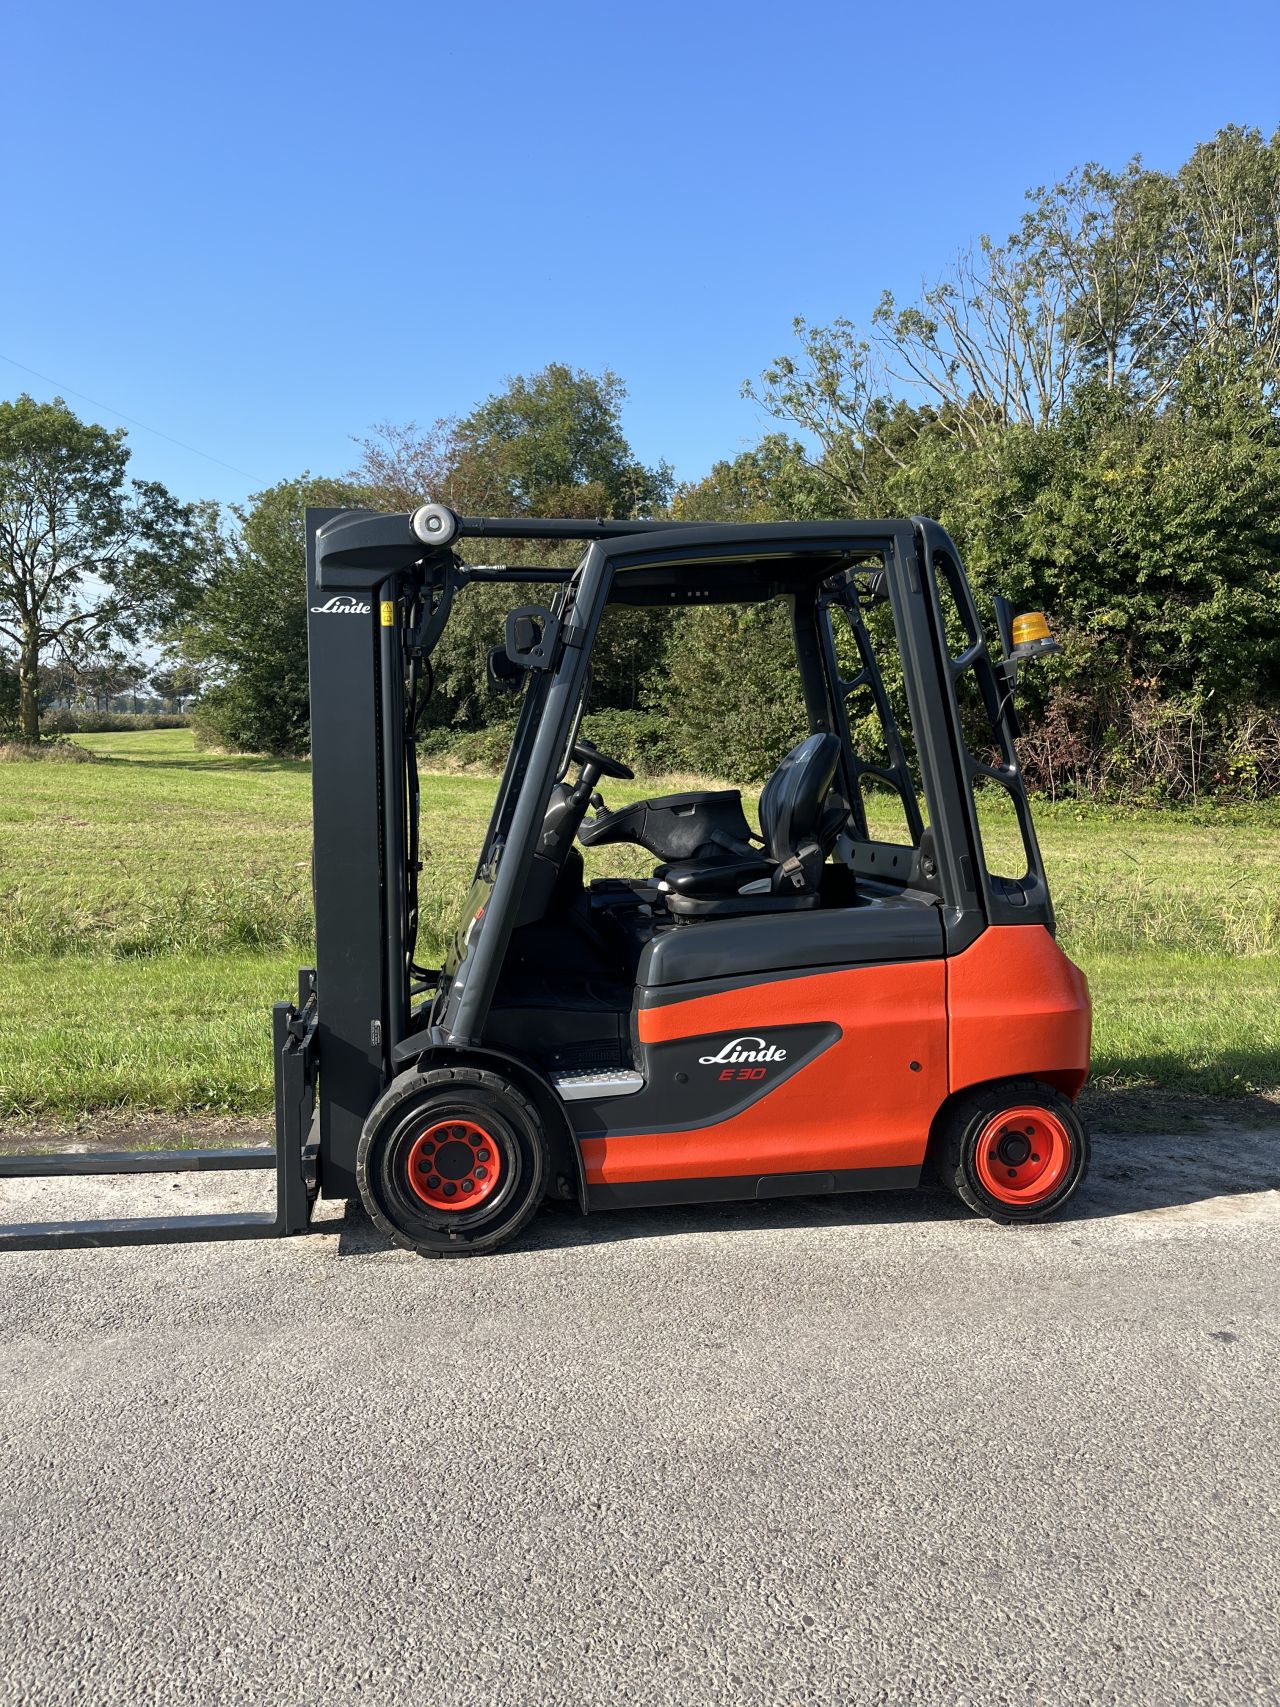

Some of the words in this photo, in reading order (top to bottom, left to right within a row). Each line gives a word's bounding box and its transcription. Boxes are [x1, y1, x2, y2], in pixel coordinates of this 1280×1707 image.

[310, 595, 371, 614] Linde
[698, 1036, 787, 1065] Linde
[718, 1068, 736, 1081] E
[736, 1067, 767, 1081] 30
